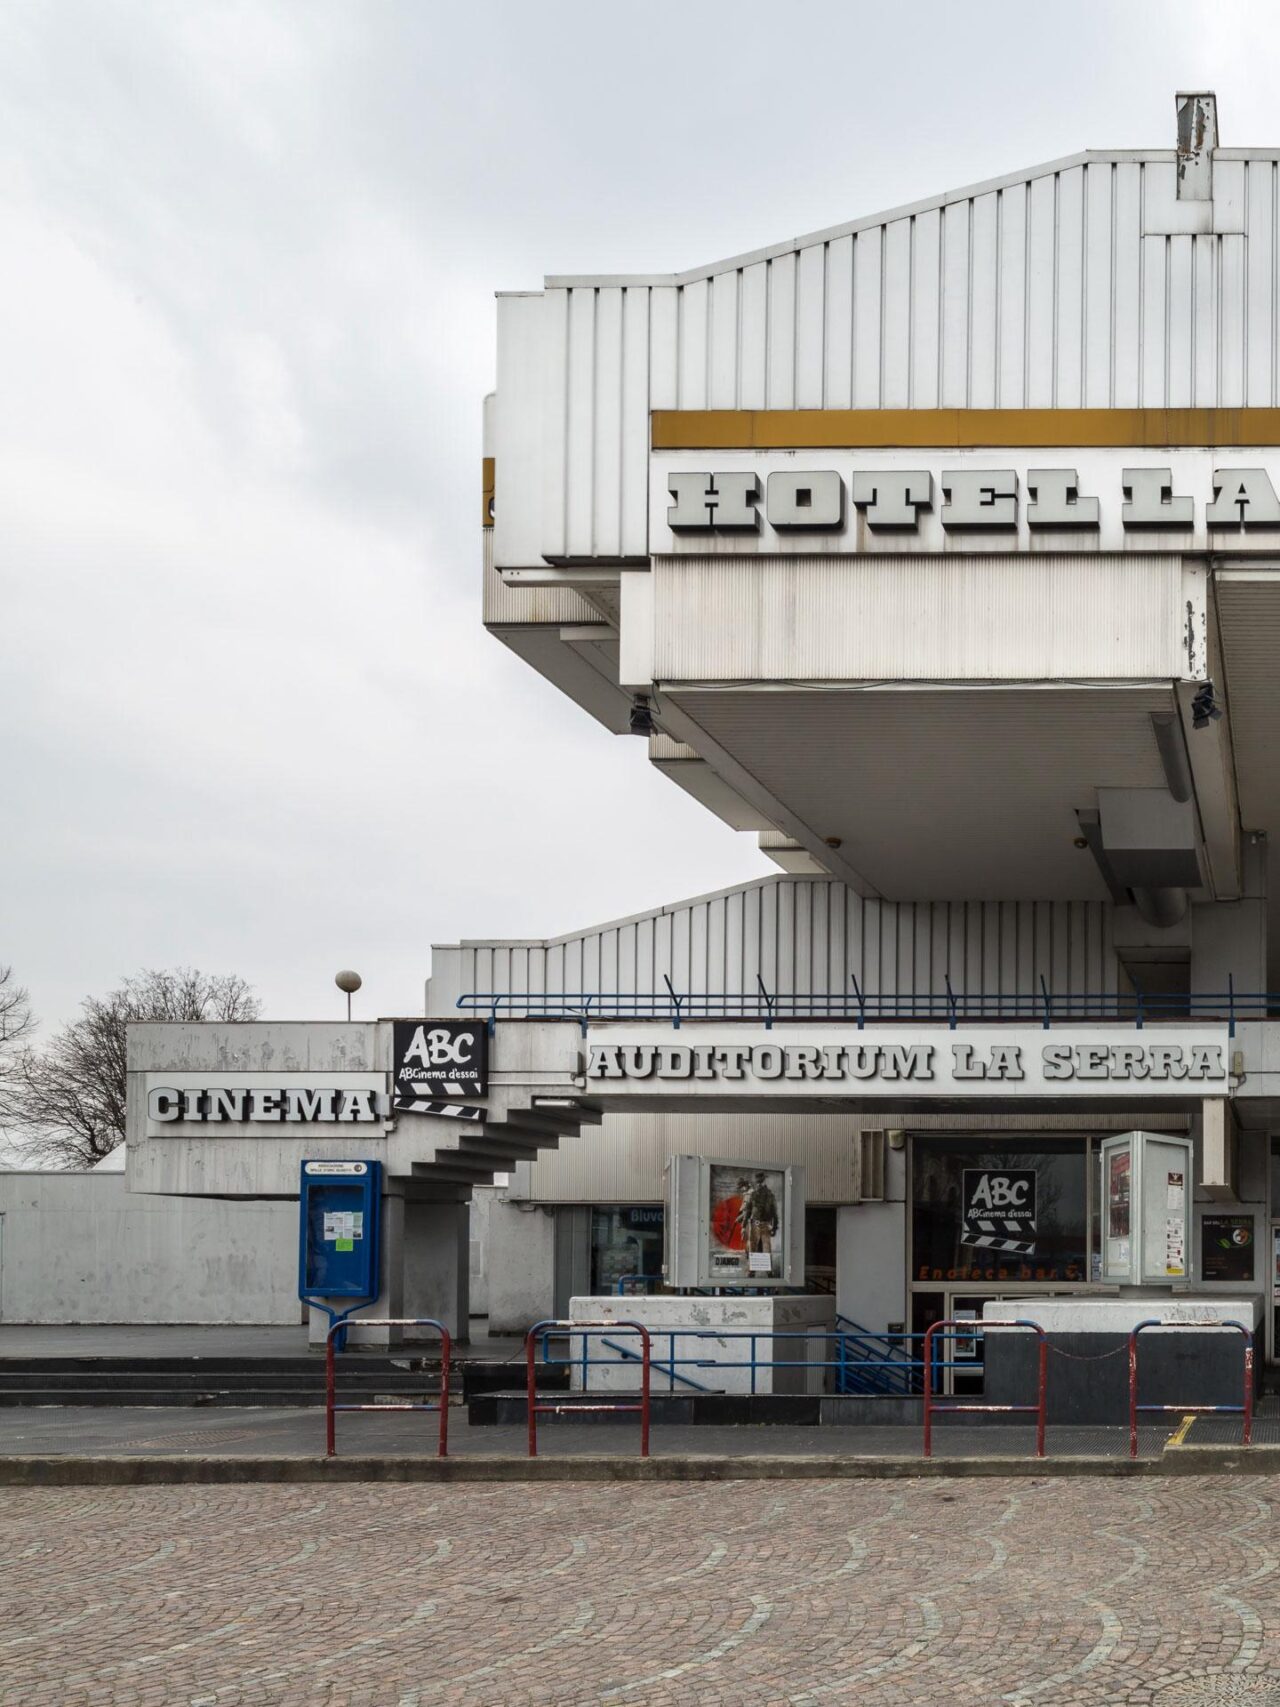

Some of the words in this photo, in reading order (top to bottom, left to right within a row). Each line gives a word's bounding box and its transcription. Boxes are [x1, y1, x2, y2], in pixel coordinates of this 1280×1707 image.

[667, 469, 1100, 532] HOTEL
[403, 1025, 475, 1068] ABC
[586, 1044, 934, 1080] AUDITORIUM
[951, 1044, 1025, 1080] LA
[1042, 1044, 1226, 1080] SERRA
[399, 1067, 447, 1081] ABCinema
[448, 1068, 478, 1079] d'essai
[147, 1086, 377, 1122] CINEMA
[971, 1174, 1029, 1209] ABC
[967, 1208, 1006, 1220] ABCinema
[919, 1263, 1009, 1280] Enoteca
[1020, 1264, 1057, 1280] bar
